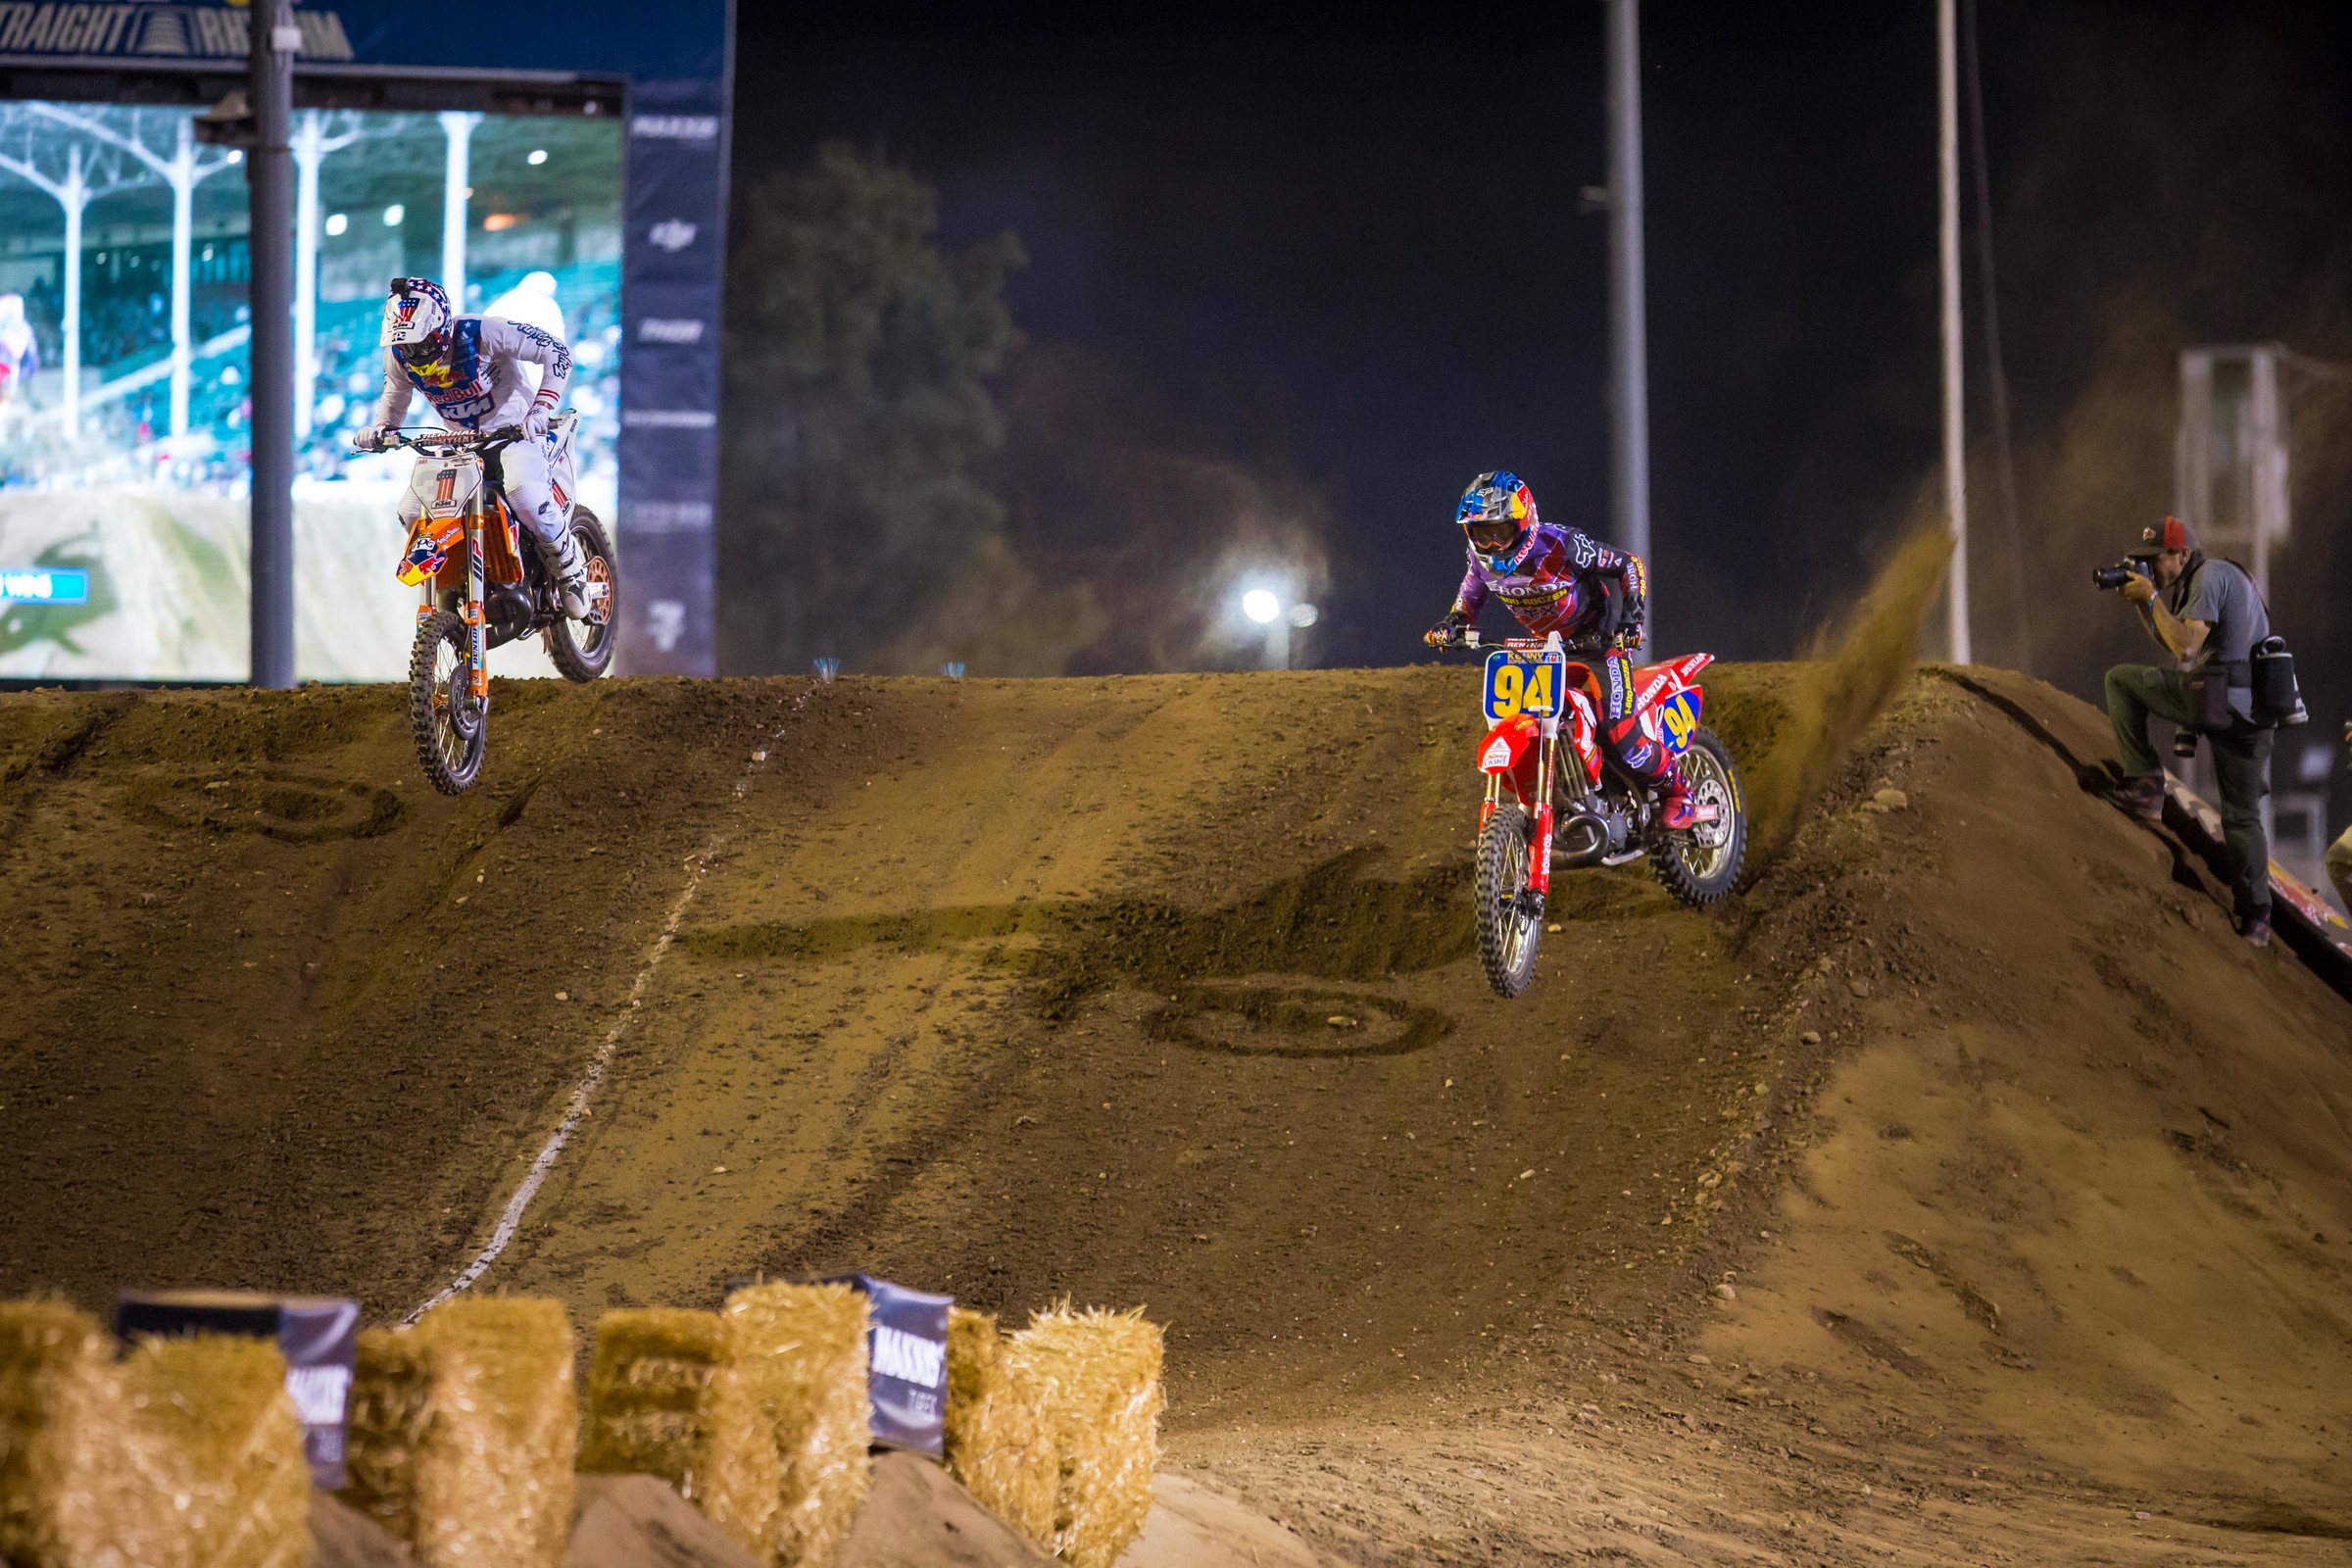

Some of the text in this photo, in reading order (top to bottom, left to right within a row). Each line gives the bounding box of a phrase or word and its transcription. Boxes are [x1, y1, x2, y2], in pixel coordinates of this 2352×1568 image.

[424, 379, 484, 404] Red Bull
[440, 397, 491, 419] KTM
[1498, 580, 1573, 596] HONDA
[1493, 664, 1552, 718] 94
[1607, 656, 1624, 719] HONDA
[1638, 673, 1668, 710] HONDA
[1664, 695, 1696, 749] 94
